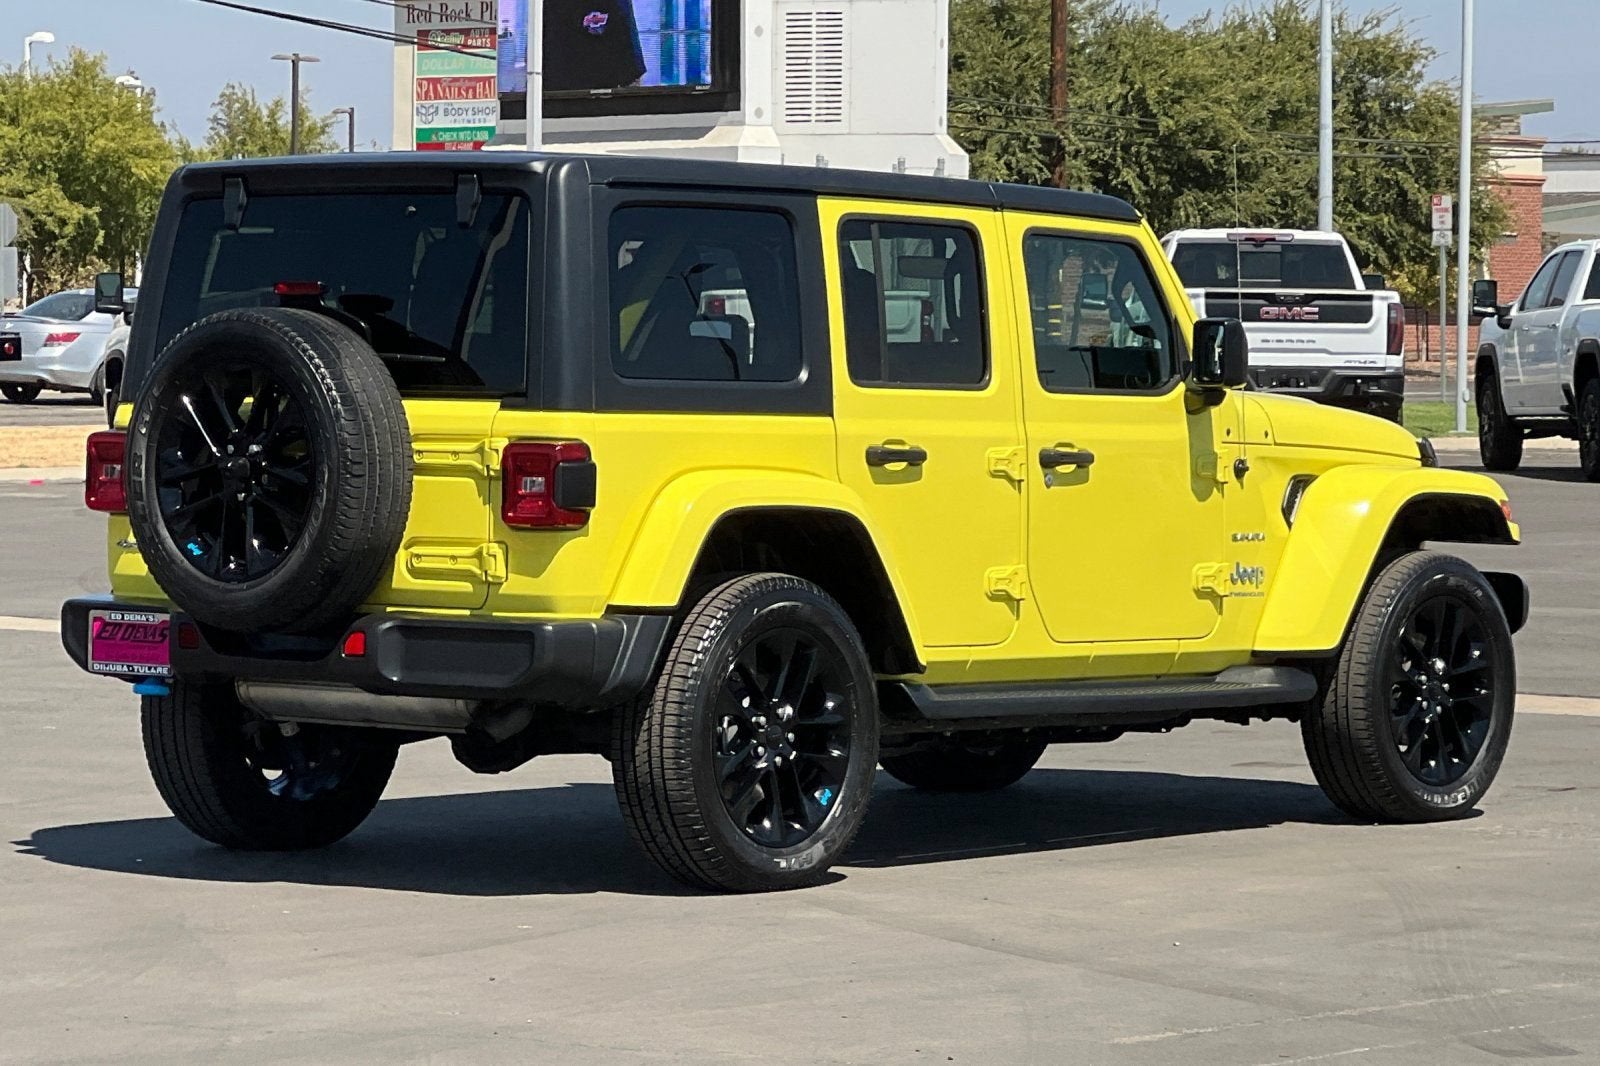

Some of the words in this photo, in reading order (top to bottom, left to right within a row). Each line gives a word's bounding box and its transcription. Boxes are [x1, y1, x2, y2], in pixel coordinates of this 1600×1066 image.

[406, 4, 432, 24] Red
[440, 2, 473, 23] Rock
[470, 29, 490, 38] AUTO
[468, 39, 491, 47] PARTS
[416, 80, 435, 100] SPA
[437, 83, 466, 100] NAILS
[443, 107, 470, 117] BODY
[438, 131, 458, 141] CHECK
[1260, 306, 1319, 320] GMC
[1230, 561, 1264, 589] Jeep
[111, 613, 122, 621] ED
[93, 663, 129, 672] DINUBA
[134, 665, 169, 674] TULARE
